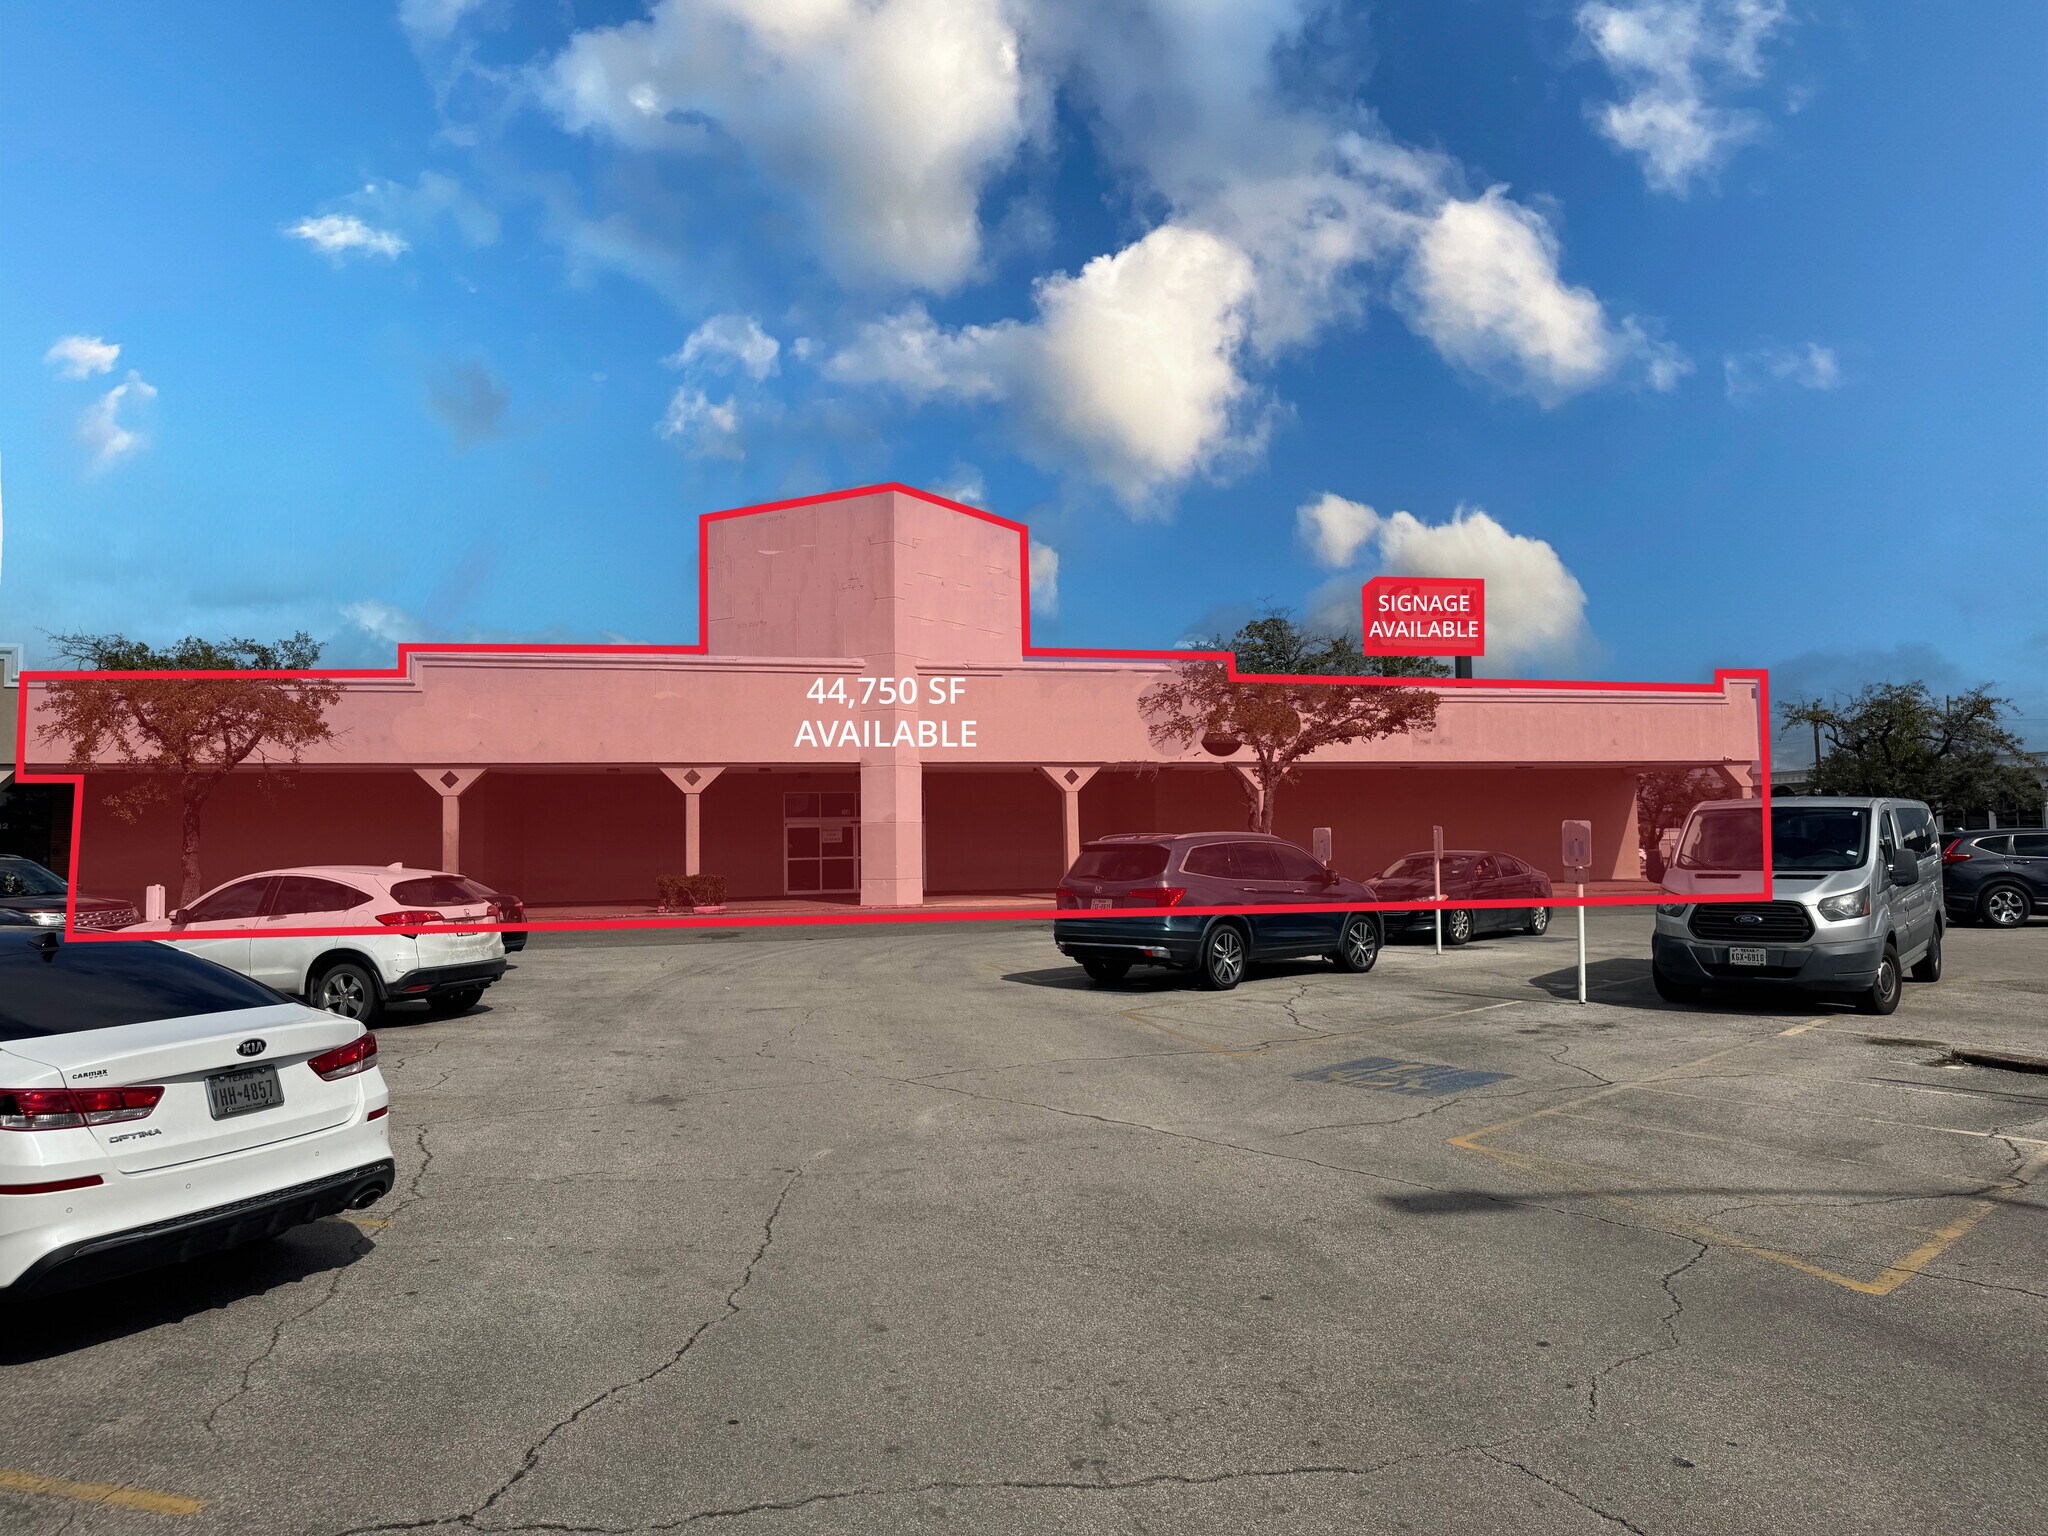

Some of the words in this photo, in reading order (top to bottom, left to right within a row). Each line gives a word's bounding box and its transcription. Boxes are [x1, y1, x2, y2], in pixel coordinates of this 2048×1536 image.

[242, 1041, 264, 1054] KIA
[228, 1071, 254, 1083] TEXAS
[109, 1128, 162, 1143] OPTIMA
